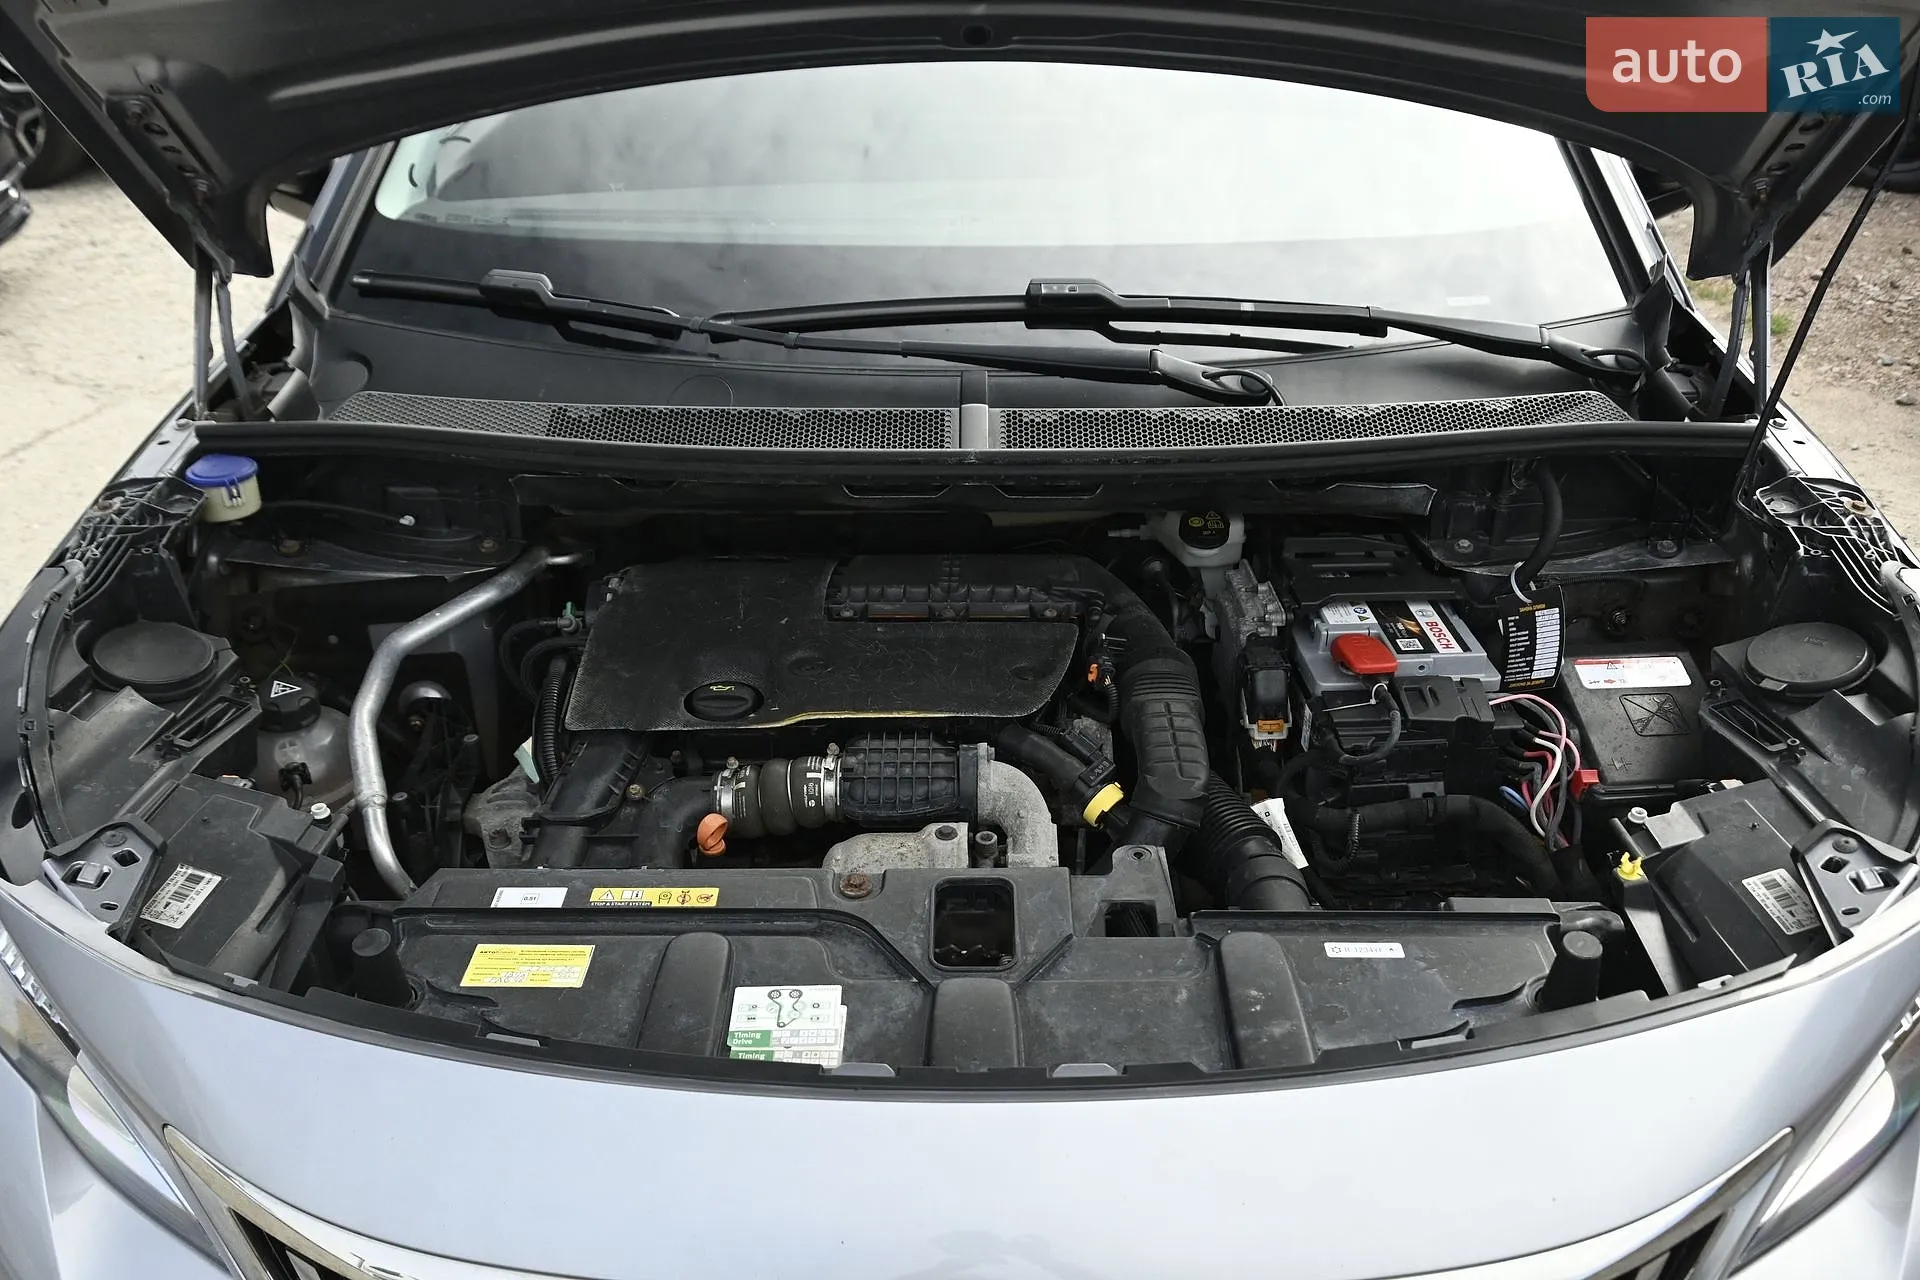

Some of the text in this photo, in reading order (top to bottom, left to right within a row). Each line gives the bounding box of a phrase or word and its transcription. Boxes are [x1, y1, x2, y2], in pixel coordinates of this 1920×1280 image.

[1424, 620, 1456, 650] BOSCH
[734, 1031, 762, 1039] Timing
[738, 1052, 766, 1060] Timing
